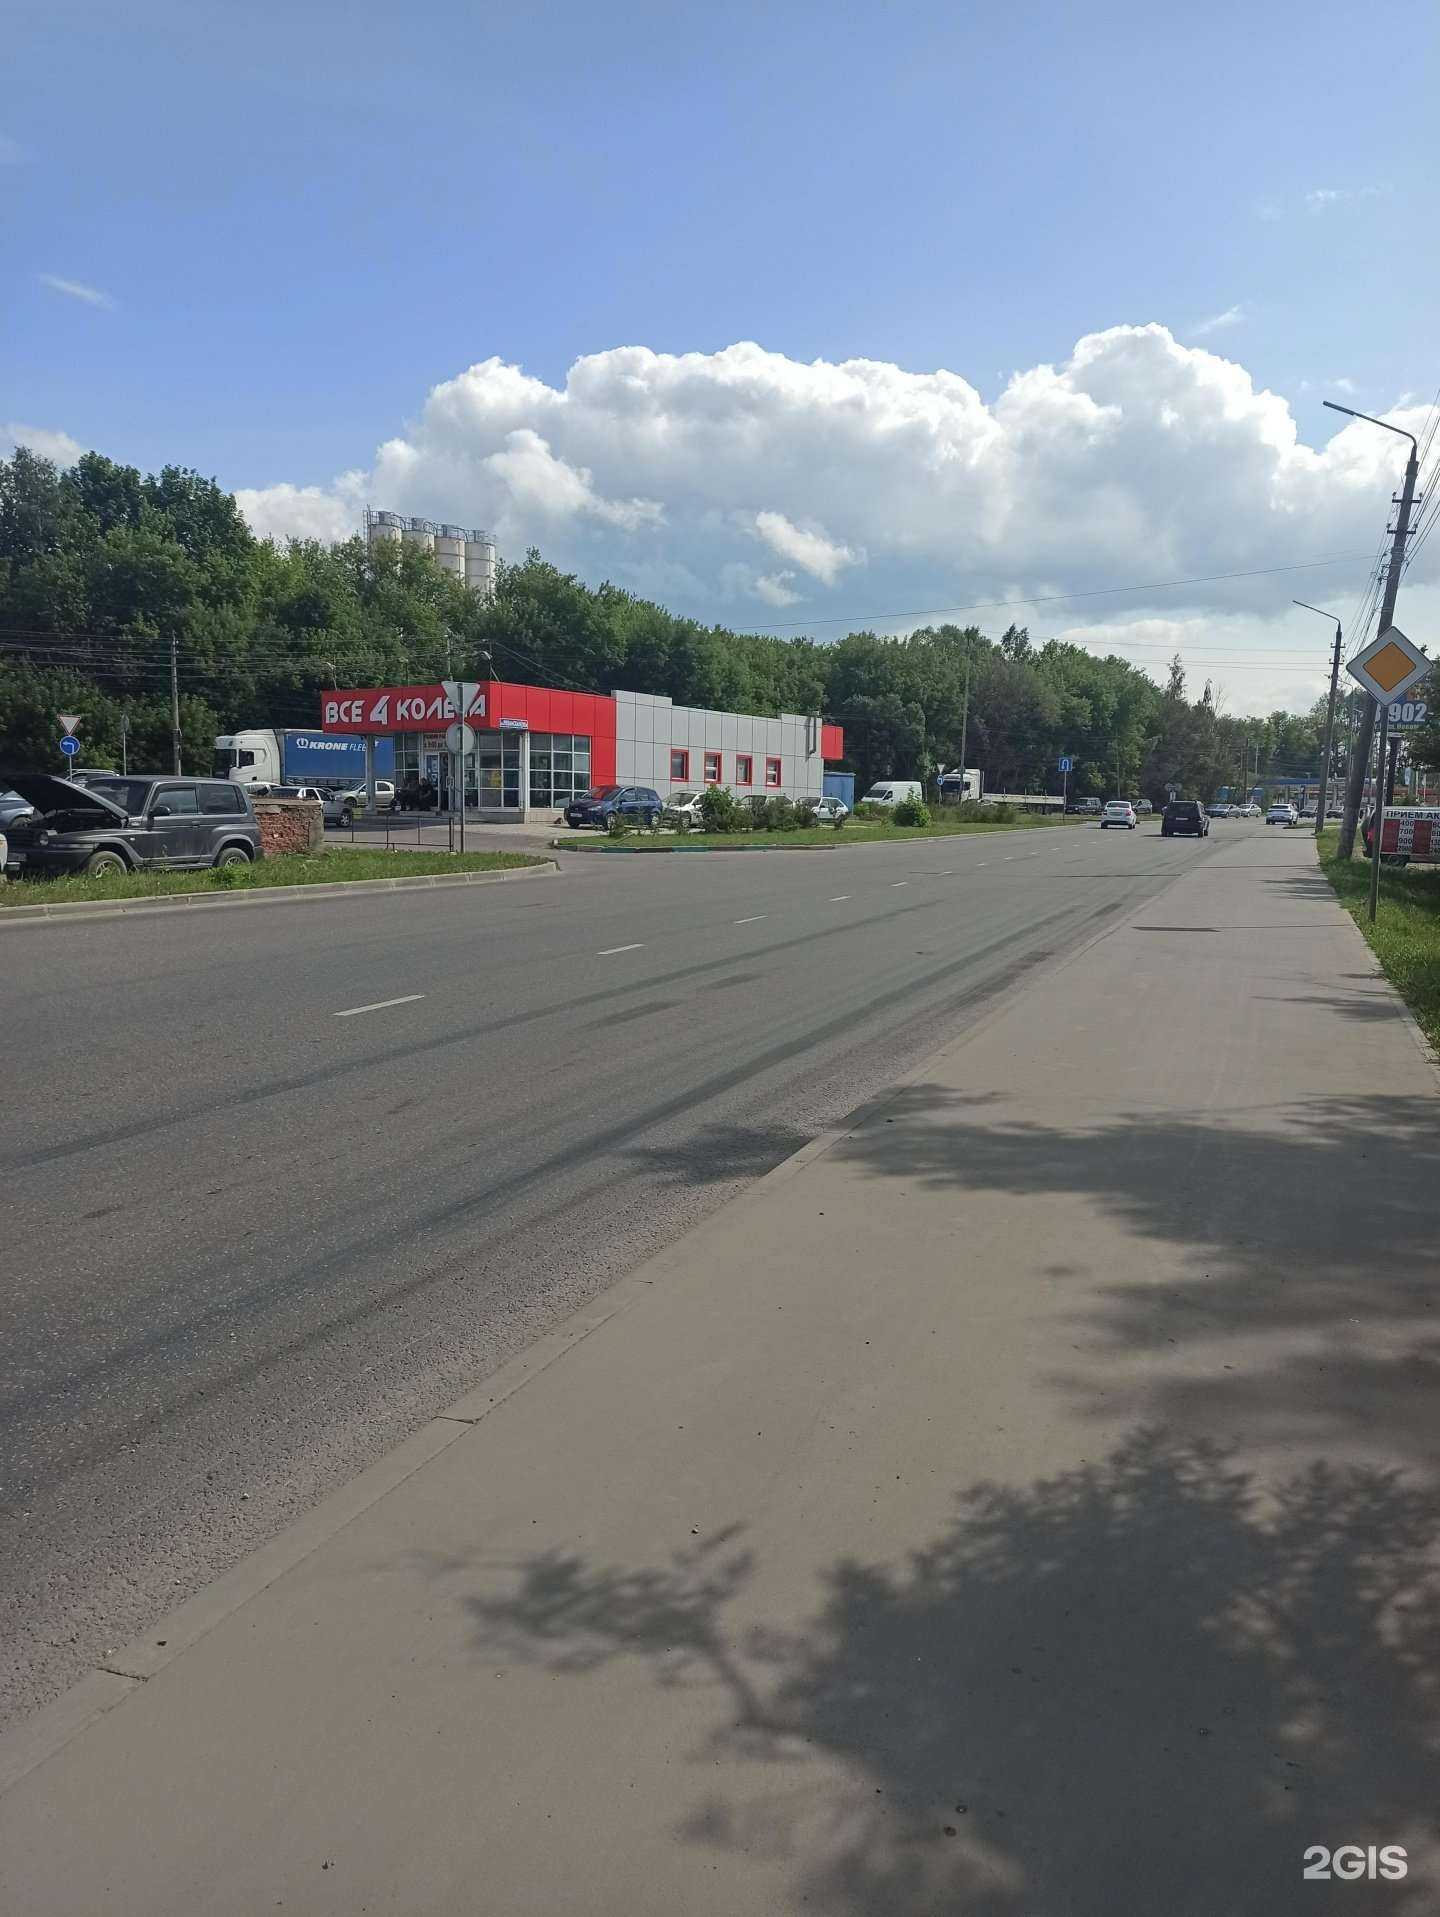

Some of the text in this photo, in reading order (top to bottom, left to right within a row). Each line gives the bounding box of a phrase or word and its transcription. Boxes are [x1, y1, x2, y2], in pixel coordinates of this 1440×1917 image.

[325, 694, 486, 725] ВСЕ 4 КОЛЕА
[1388, 702, 1427, 722] 902
[309, 741, 349, 751] KRONE
[1386, 810, 1423, 819] ПРИЕМ
